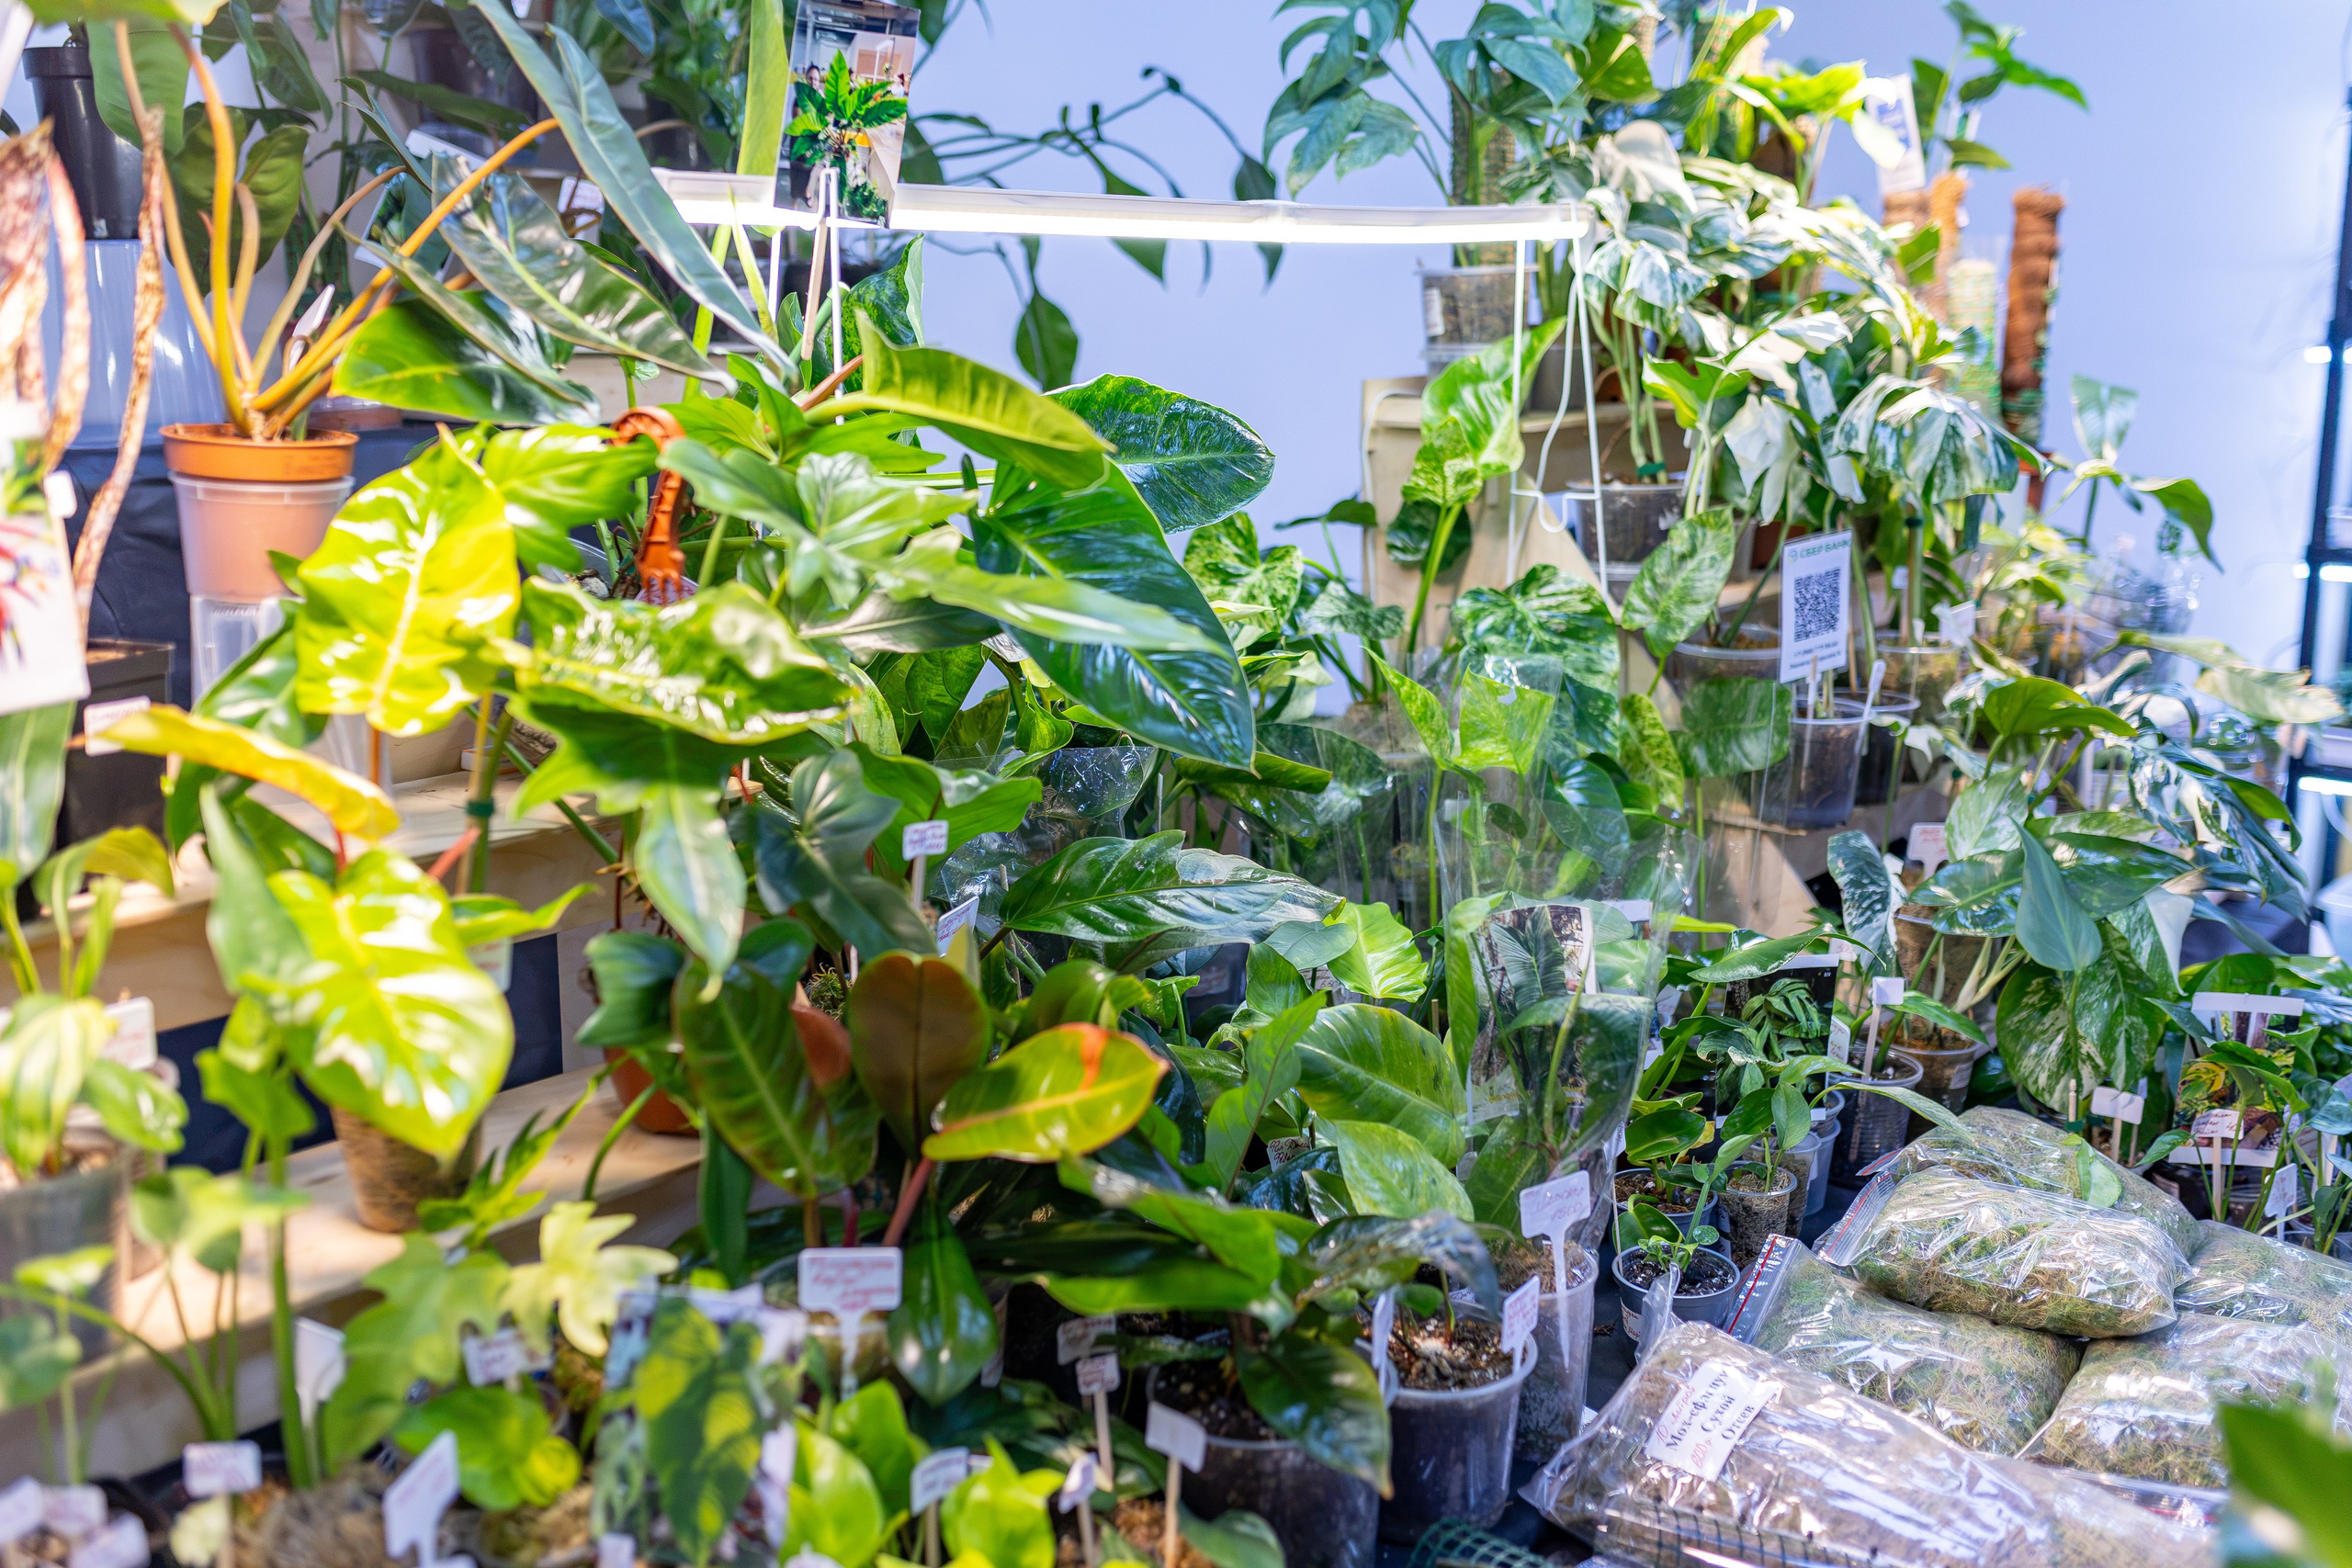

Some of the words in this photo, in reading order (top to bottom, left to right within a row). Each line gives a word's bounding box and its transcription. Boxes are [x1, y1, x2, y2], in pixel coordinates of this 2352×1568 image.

[1701, 1395, 1736, 1432] Сухой
[1722, 1405, 1755, 1439] Отсев
[1657, 1425, 1668, 1444] 10
